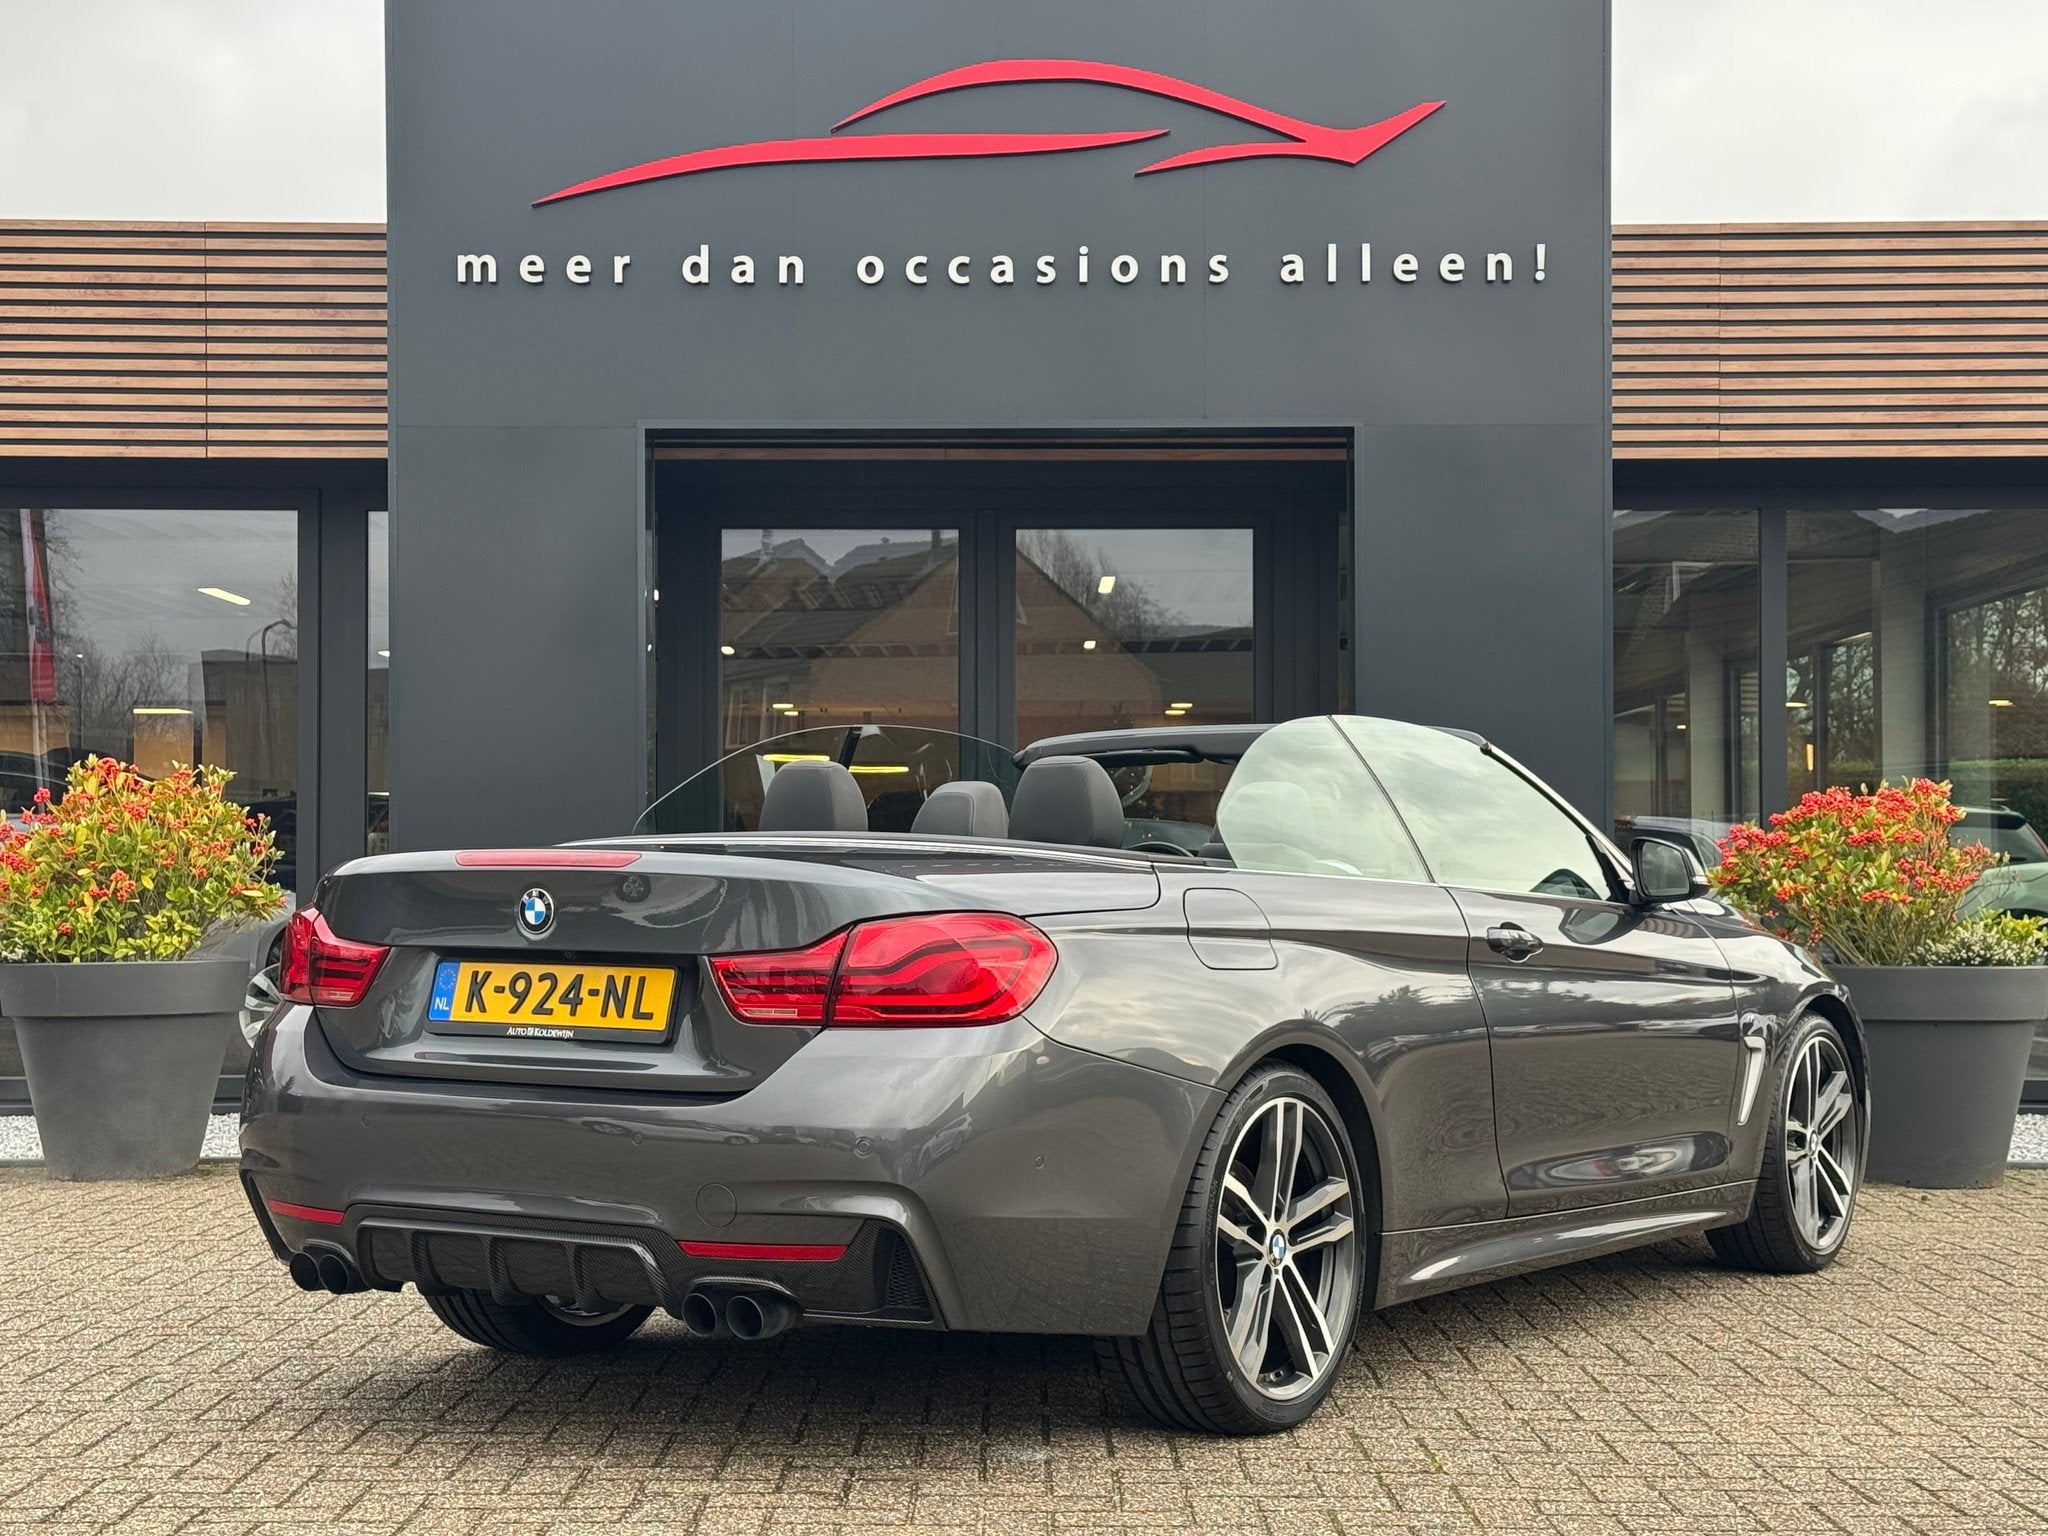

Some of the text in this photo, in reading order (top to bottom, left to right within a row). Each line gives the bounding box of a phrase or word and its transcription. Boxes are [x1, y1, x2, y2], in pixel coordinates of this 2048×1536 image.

[457, 242, 1546, 284] meer dan occasions alleen!
[434, 996, 450, 1010] NL
[464, 970, 654, 1020] K-924-NL
